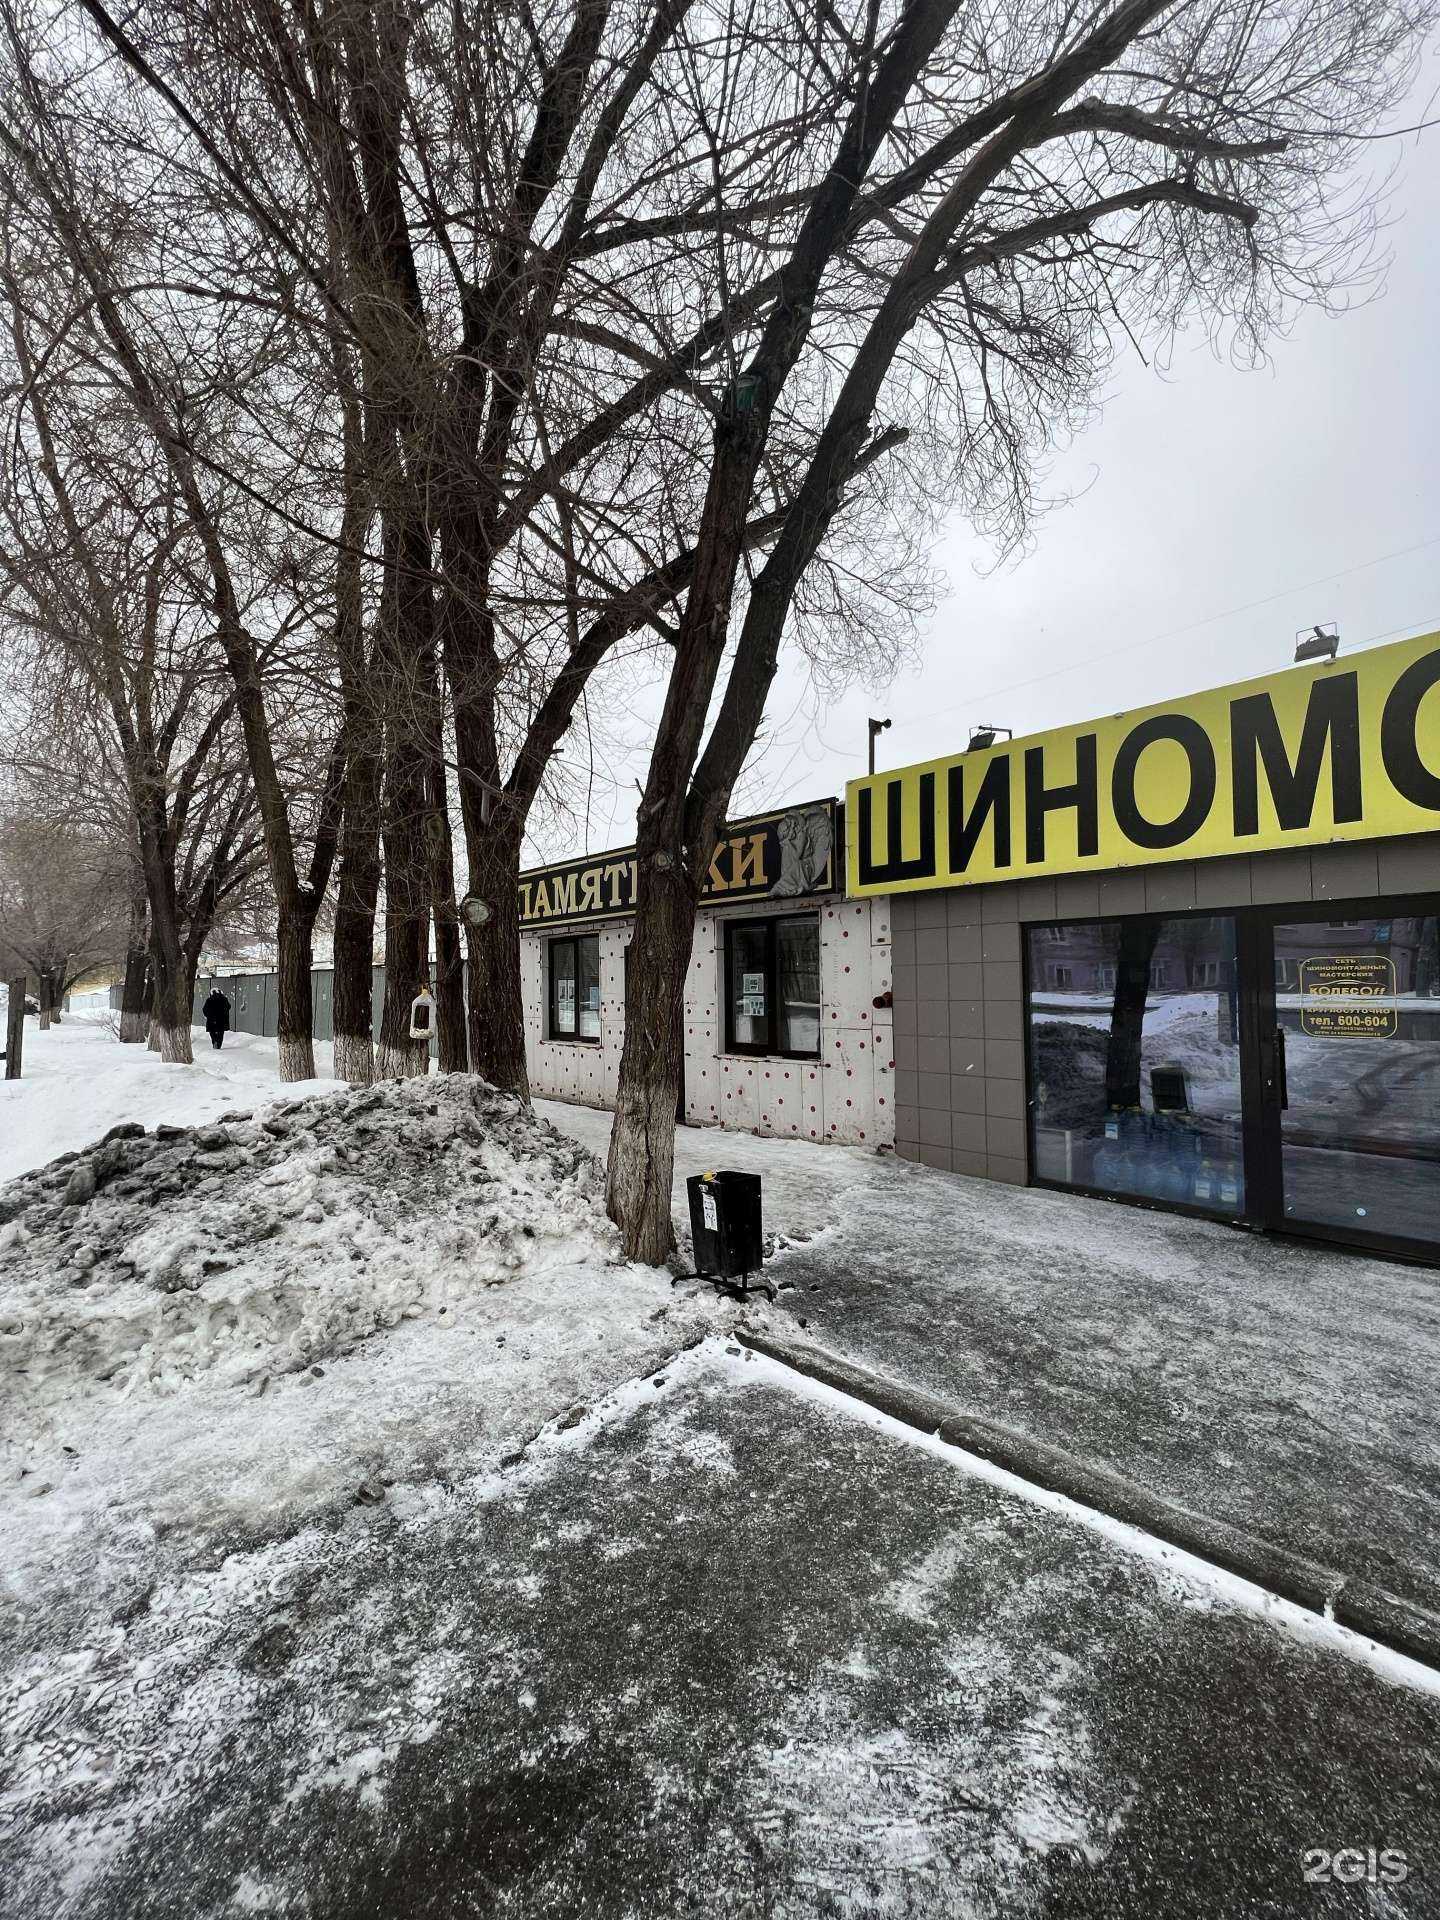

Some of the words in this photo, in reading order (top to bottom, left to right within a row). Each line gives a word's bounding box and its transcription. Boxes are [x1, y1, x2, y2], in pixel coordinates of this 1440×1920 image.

[519, 832, 769, 921] ПАМЯТКИ
[1310, 1017, 1334, 1026] тел.
[1338, 1016, 1388, 1026] 600-604
